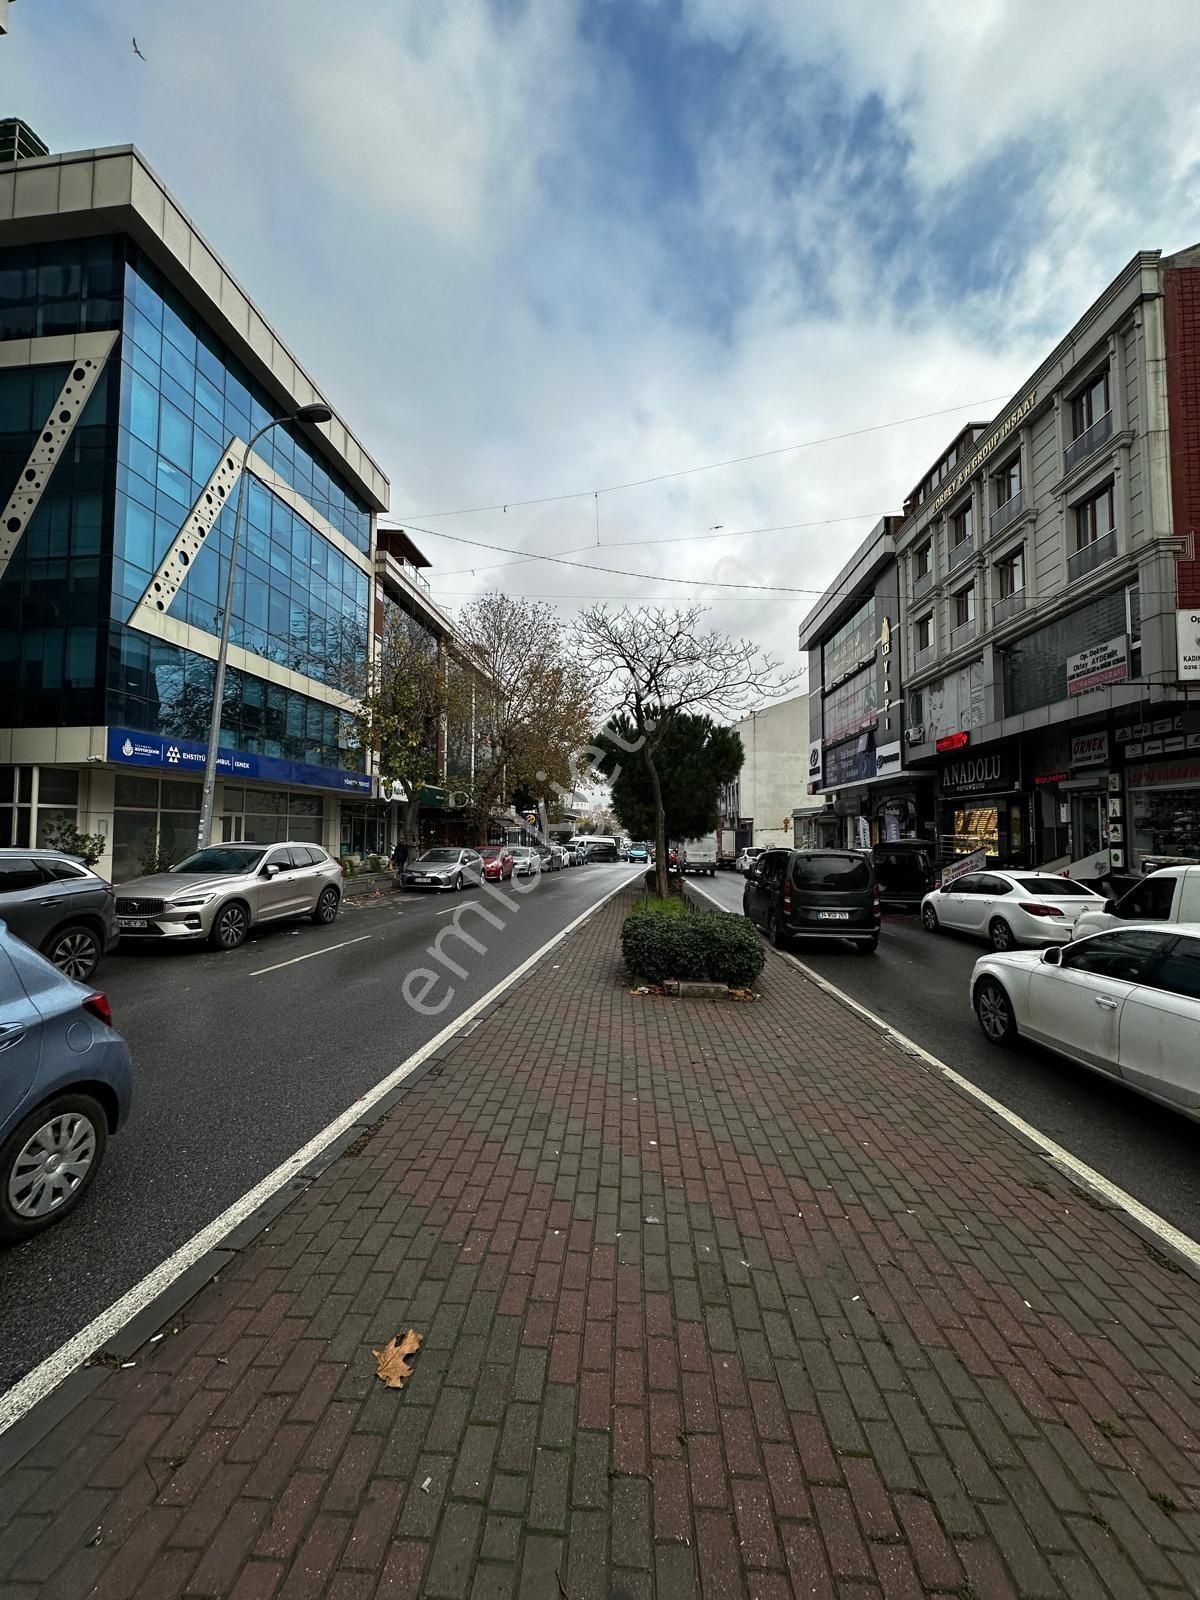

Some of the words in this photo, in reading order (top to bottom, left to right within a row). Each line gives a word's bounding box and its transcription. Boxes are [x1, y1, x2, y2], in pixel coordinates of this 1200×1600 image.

[971, 432, 1001, 468] GROUP
[1089, 645, 1109, 657] Doktor
[1073, 662, 1089, 672] Oktay
[1073, 736, 1106, 755] ÖRNEK
[182, 752, 206, 762] ENSTİTÜ
[943, 755, 1001, 786] ANADOLU
